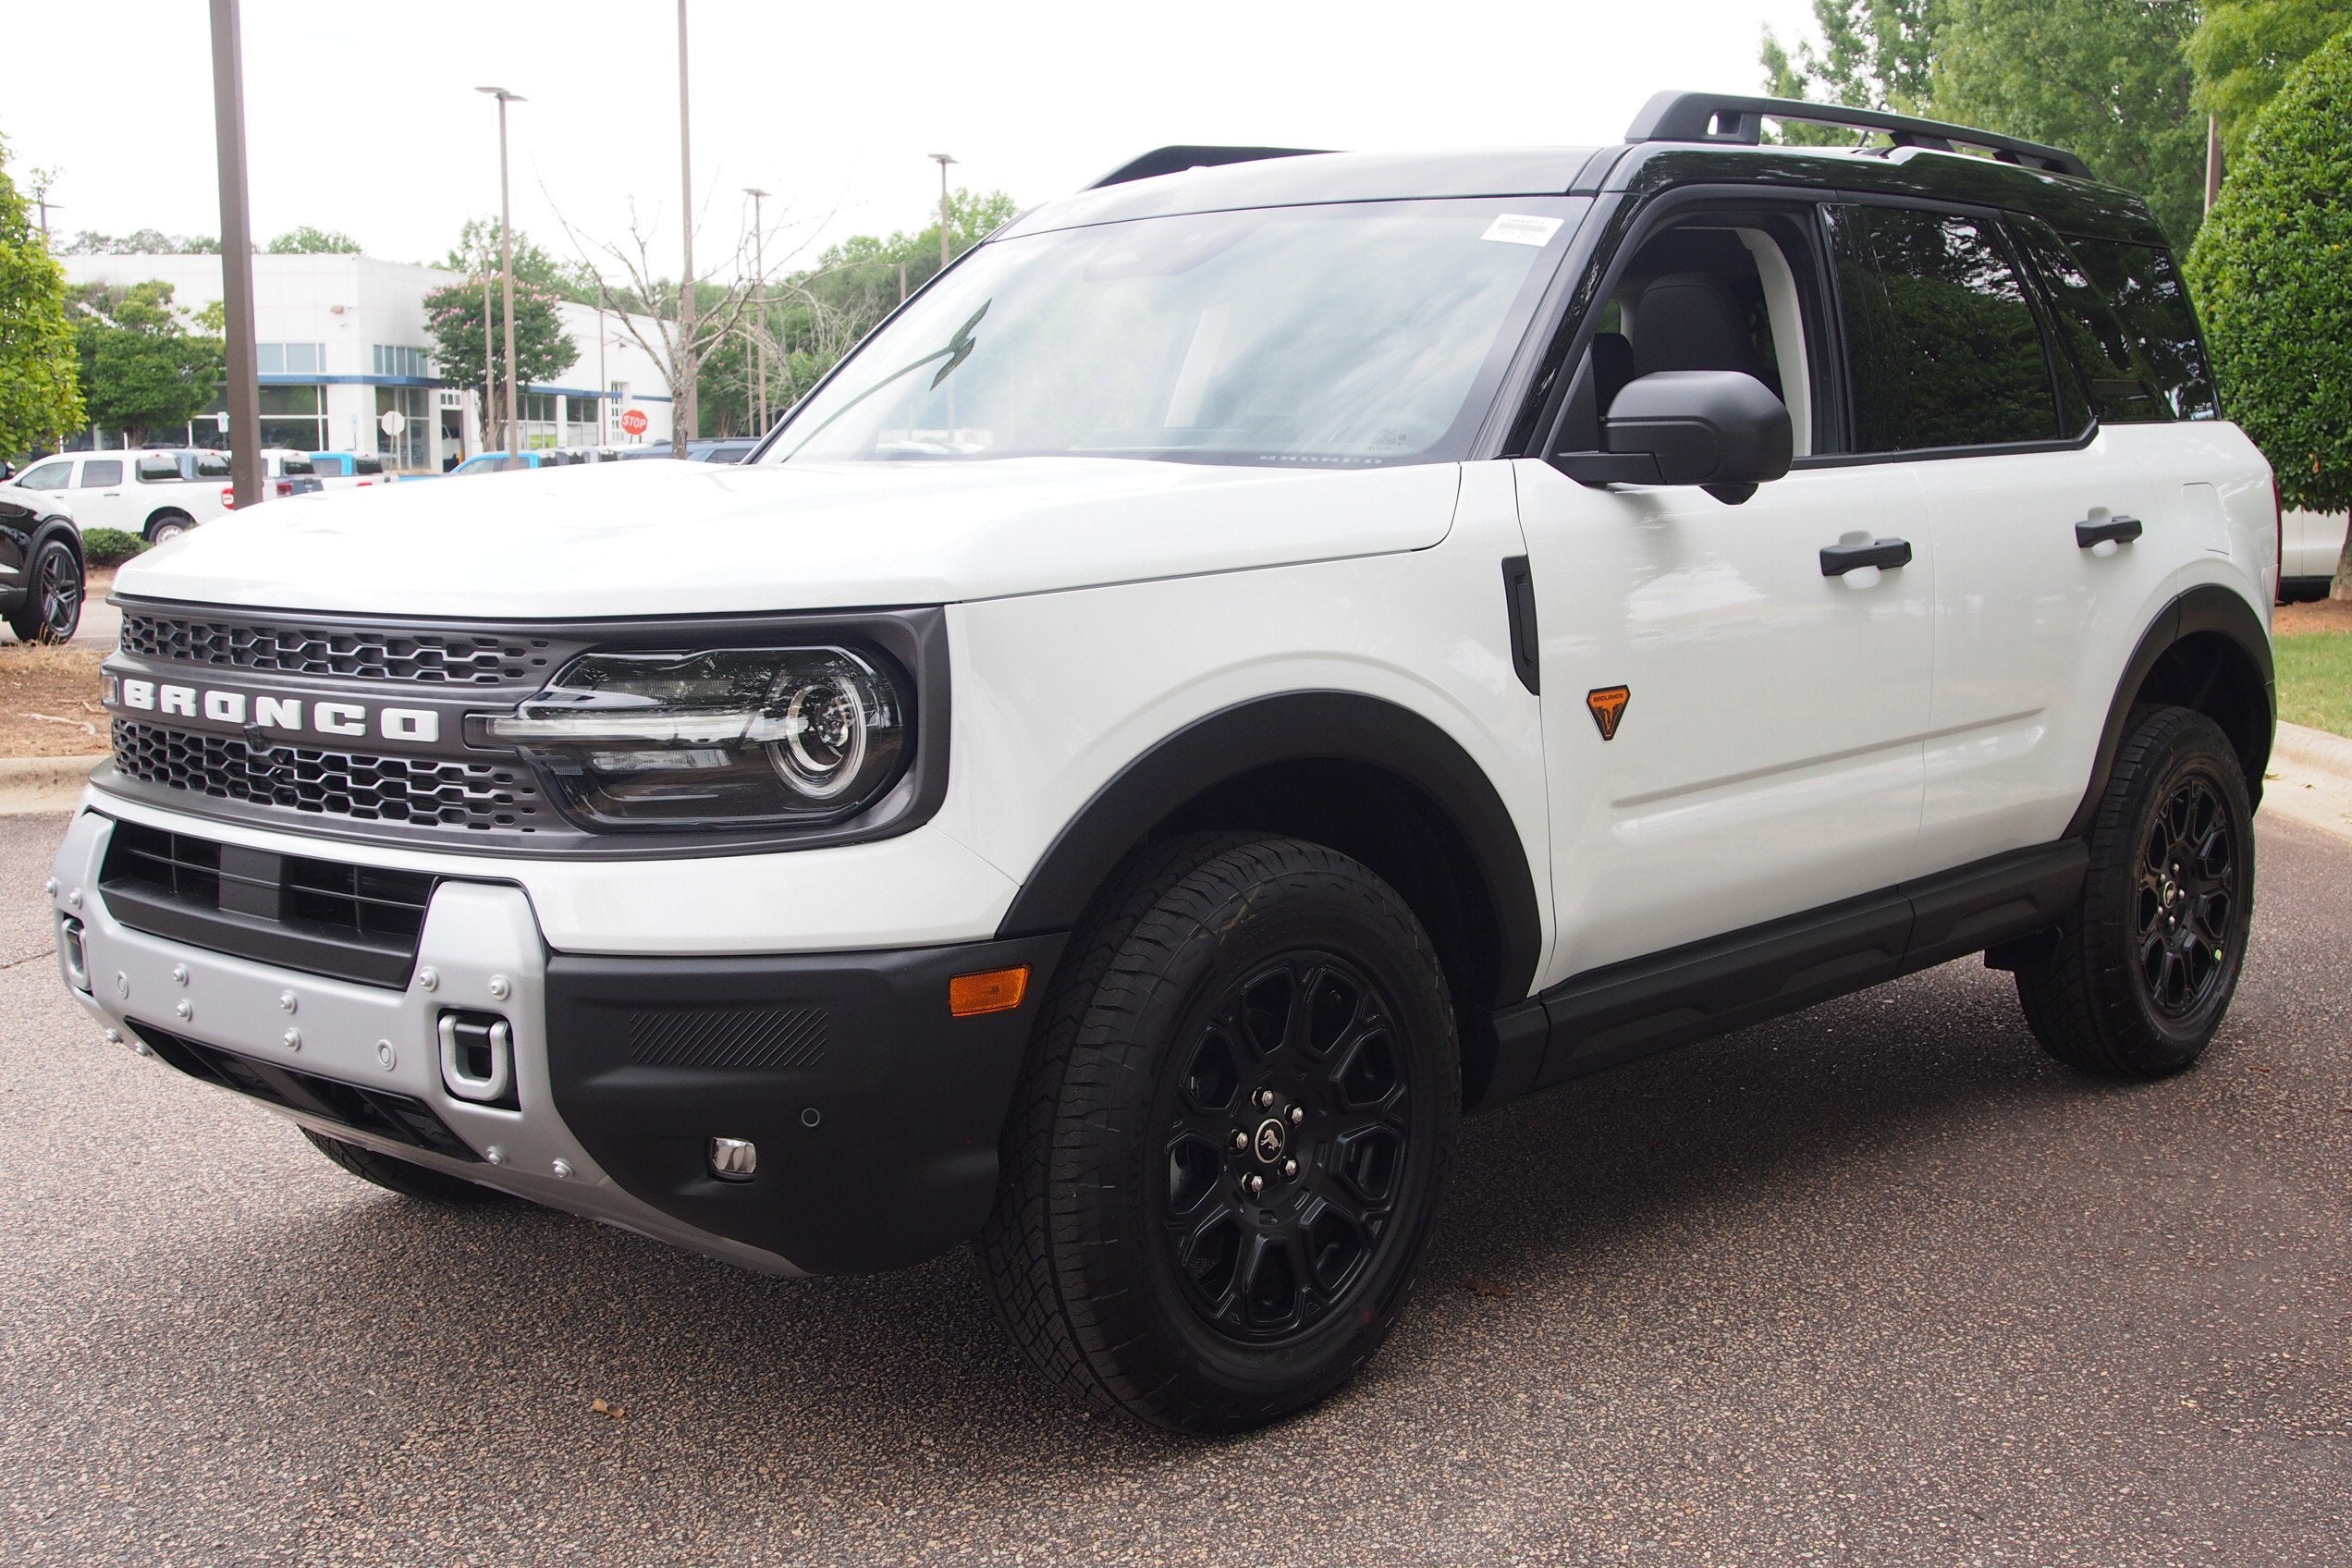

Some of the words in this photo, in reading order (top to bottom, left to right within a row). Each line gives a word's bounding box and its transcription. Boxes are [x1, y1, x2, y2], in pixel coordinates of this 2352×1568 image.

[622, 415, 647, 428] STOP
[1593, 692, 1623, 703] BADLANDS
[124, 679, 439, 742] BRONCO
